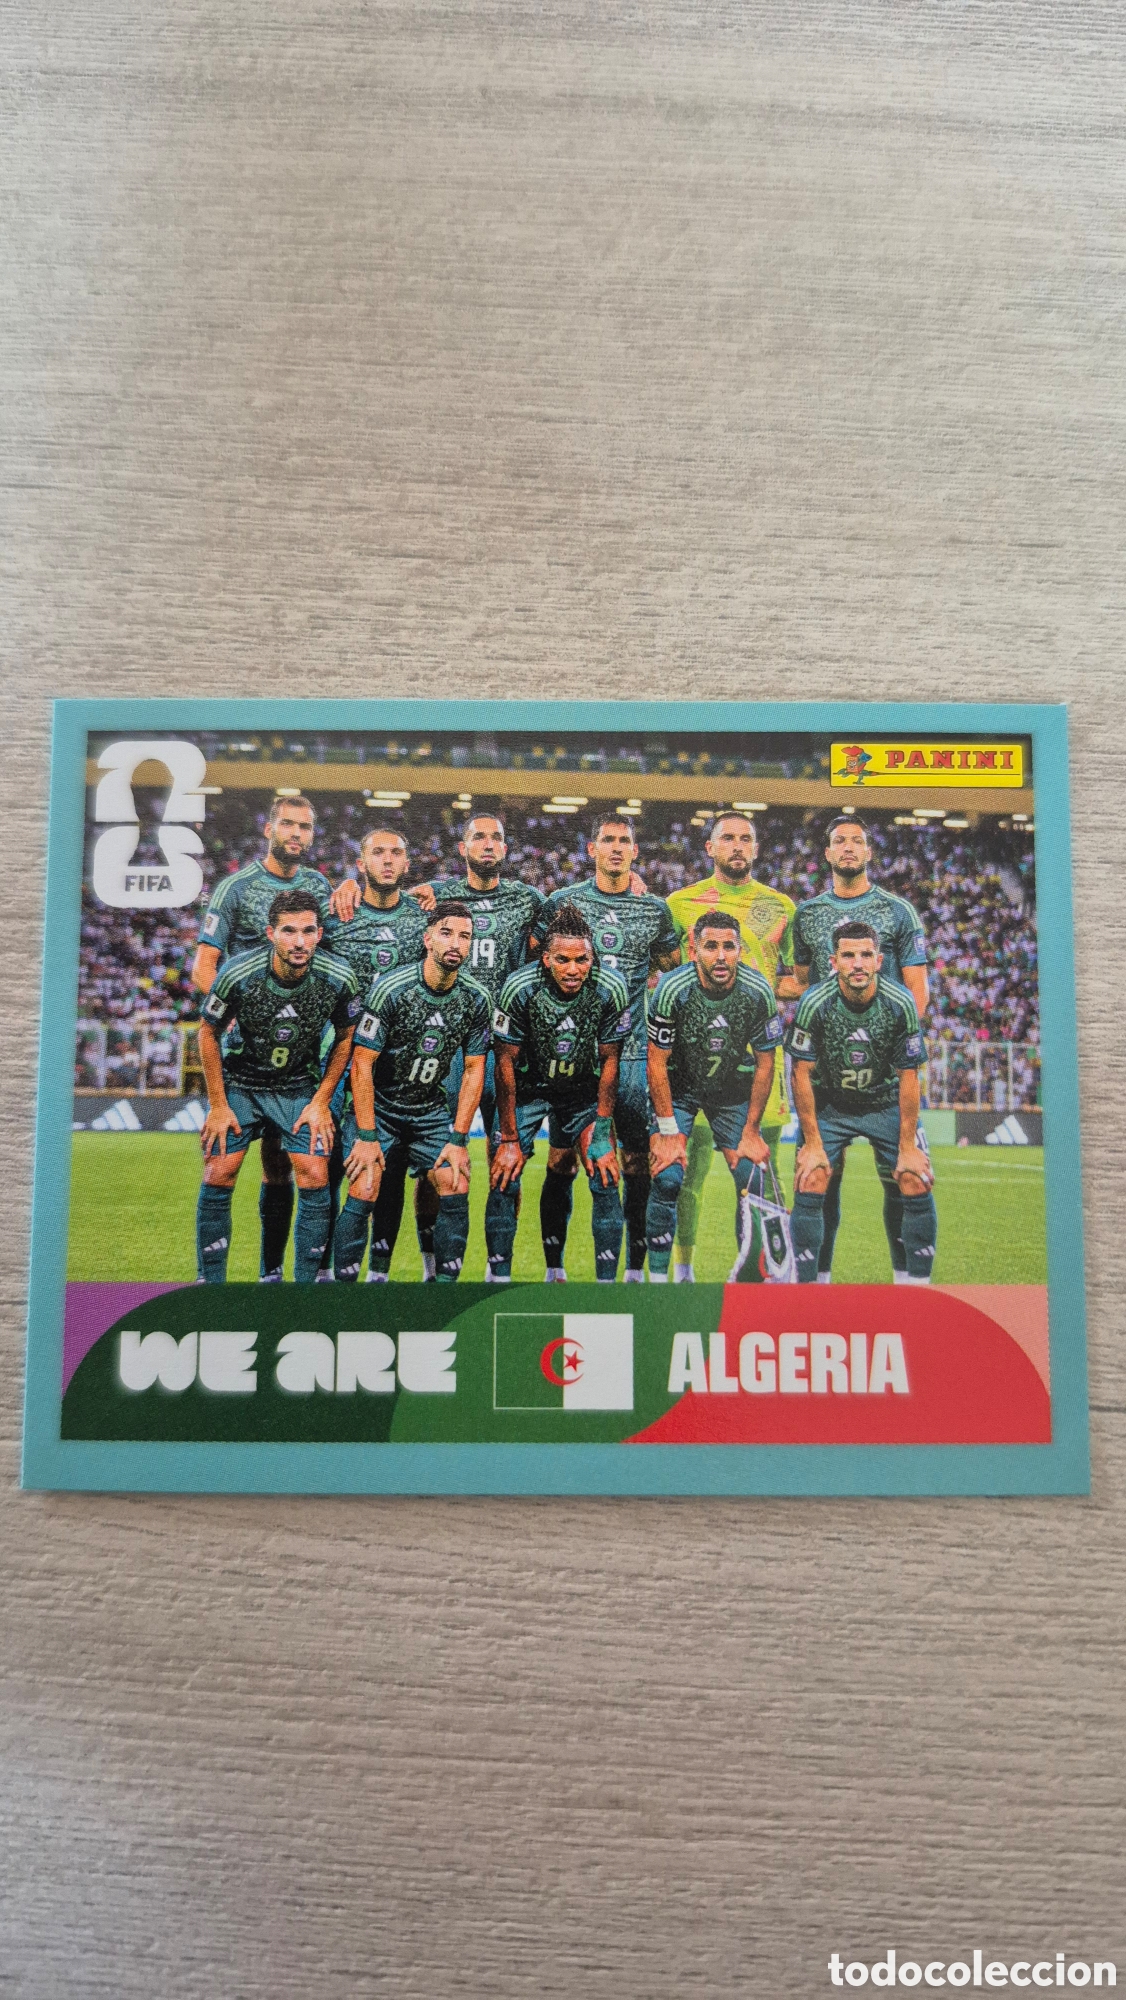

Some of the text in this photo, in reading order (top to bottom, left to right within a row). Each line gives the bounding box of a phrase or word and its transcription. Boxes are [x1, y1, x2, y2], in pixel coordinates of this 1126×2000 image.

[884, 750, 1015, 769] PANINI
[125, 874, 174, 892] FIFA
[472, 938, 496, 969] 19
[270, 1046, 290, 1069] 8
[547, 1057, 575, 1079] 14
[705, 1055, 722, 1078] 7
[408, 1056, 440, 1084] 18
[841, 1068, 872, 1090] 20
[667, 1331, 909, 1396] ALGERIA
